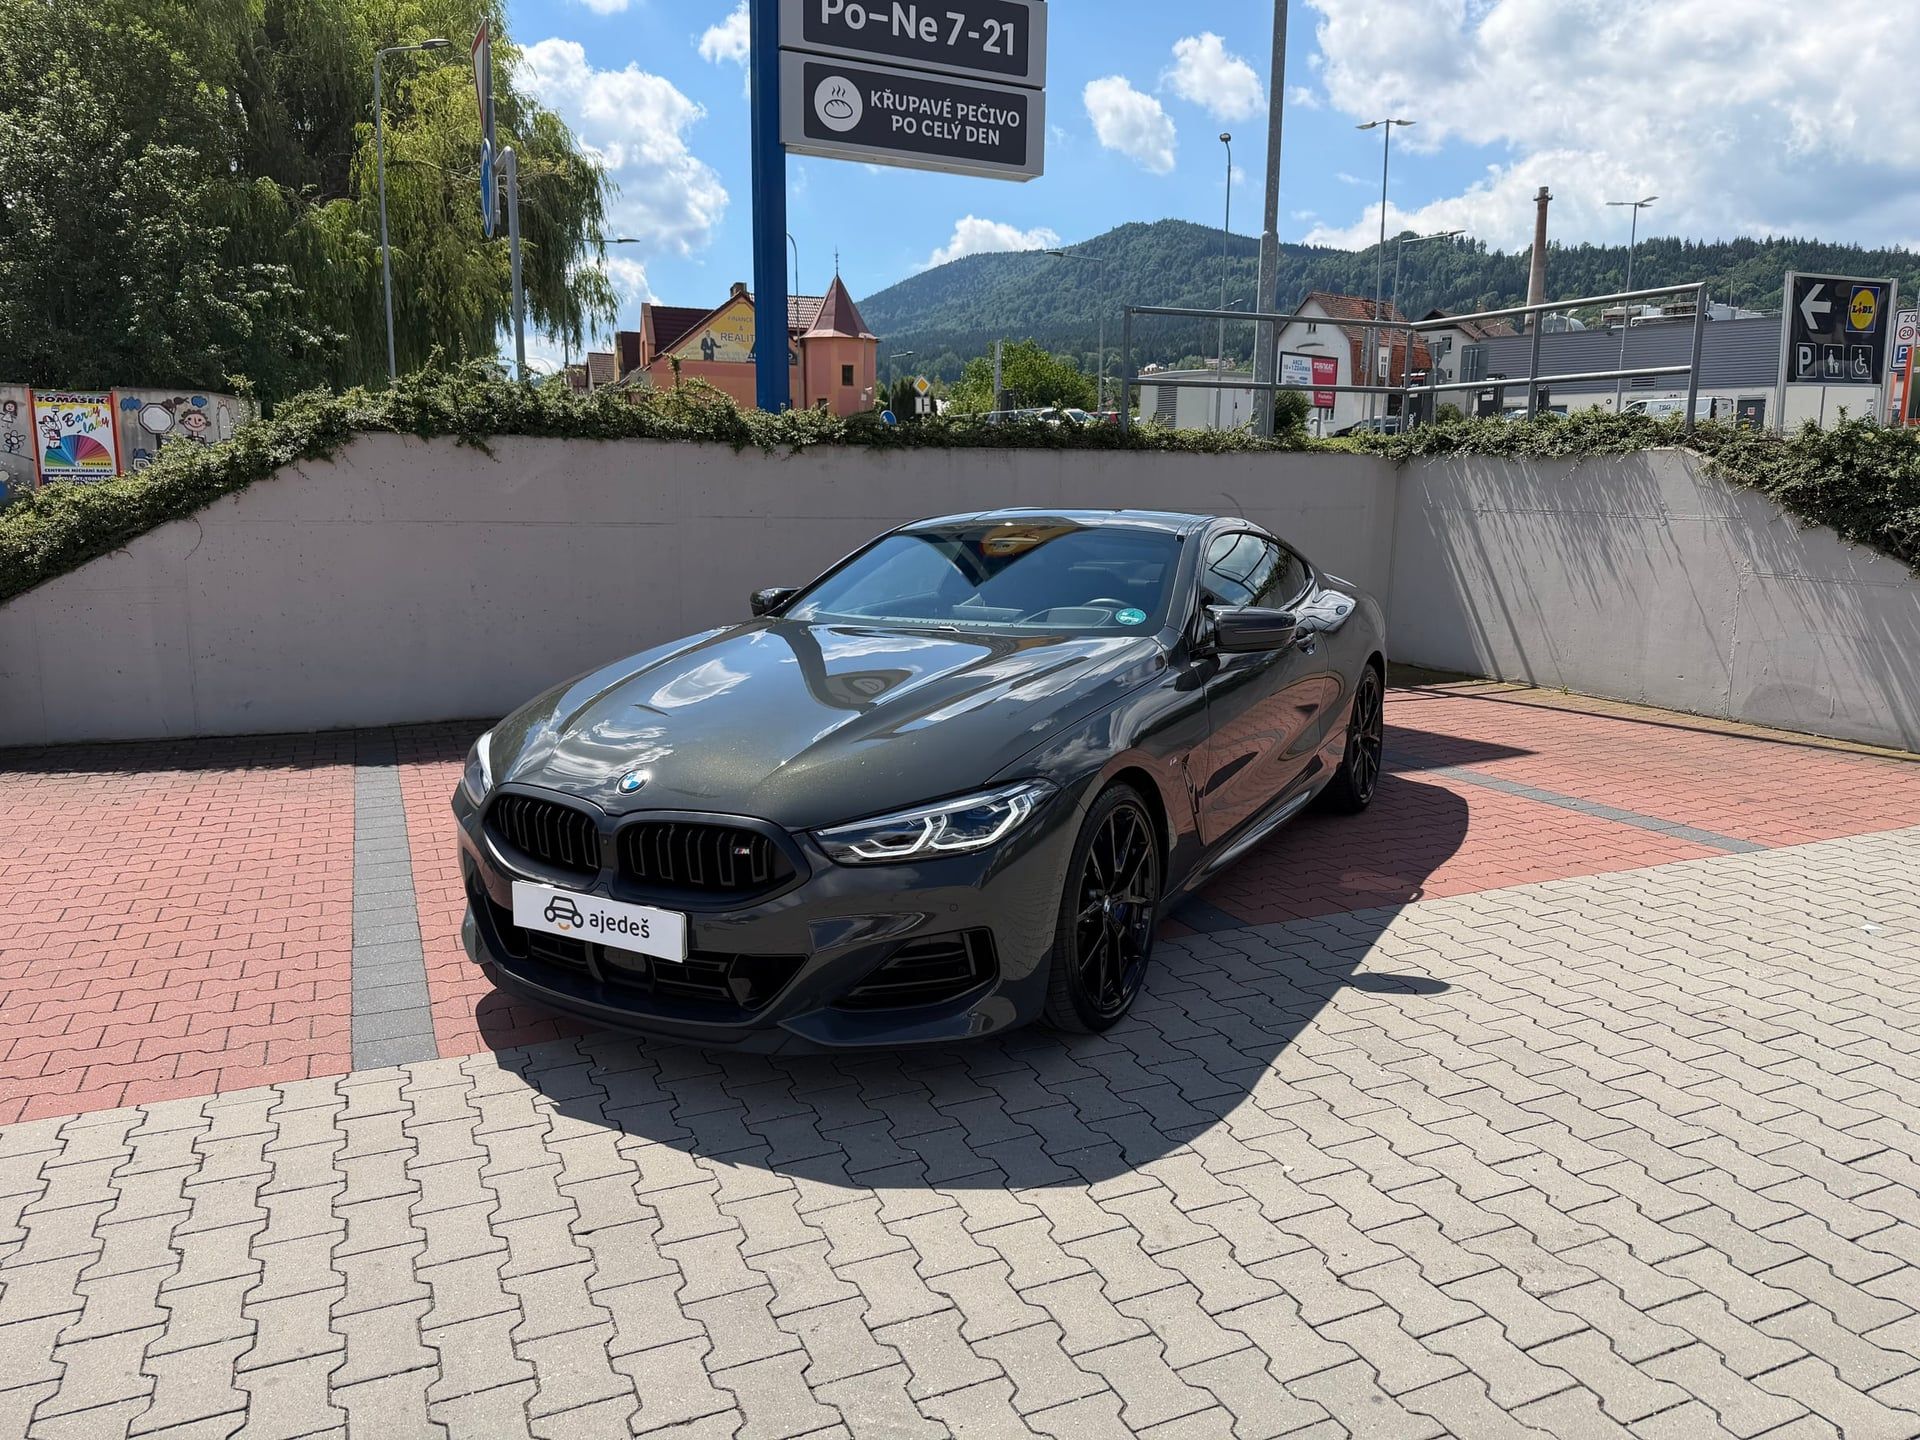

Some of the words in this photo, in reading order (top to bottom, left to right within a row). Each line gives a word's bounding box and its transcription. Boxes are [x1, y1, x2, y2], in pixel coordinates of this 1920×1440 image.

[870, 88, 952, 118] KŘUPAVÉ
[956, 103, 1020, 128] PEČIVO
[891, 115, 917, 134] PO
[921, 120, 962, 140] CELÝ
[965, 125, 1000, 146] DEN
[720, 332, 756, 343] REALIT
[1902, 329, 1912, 337] 20
[1799, 346, 1812, 374] P
[589, 909, 650, 939] ajedeš
